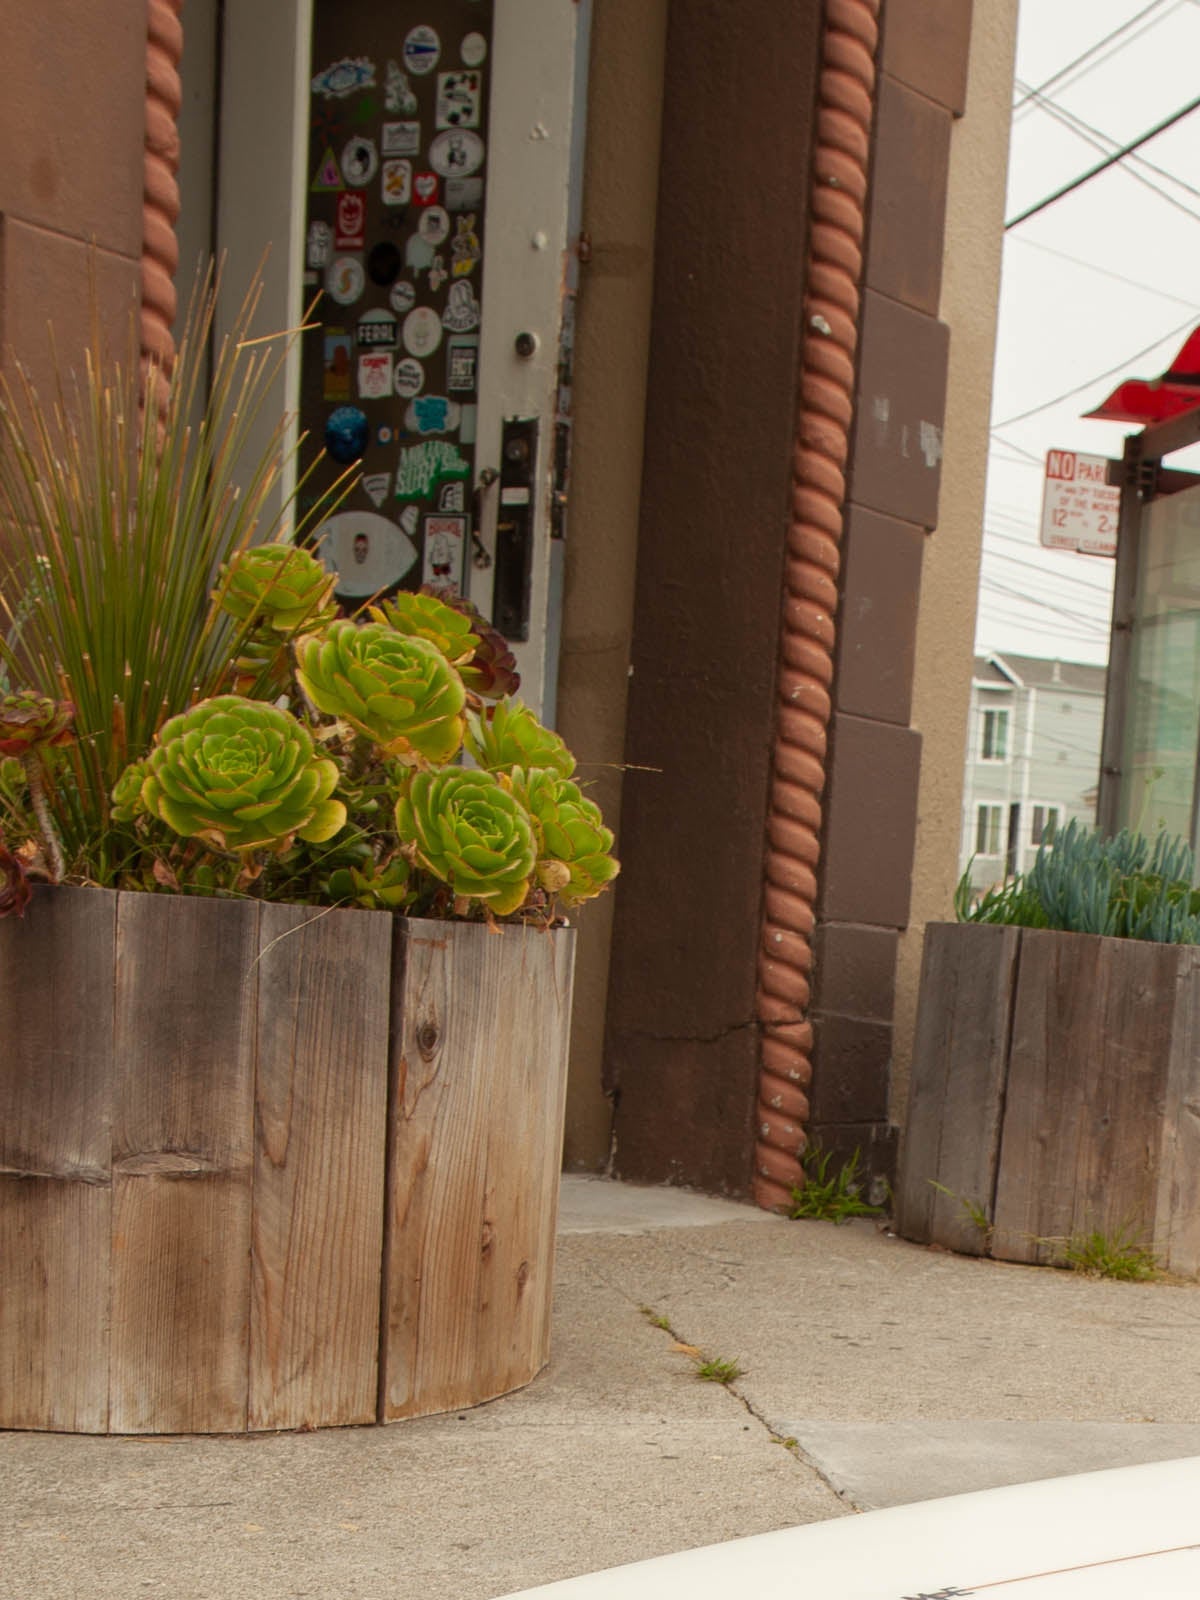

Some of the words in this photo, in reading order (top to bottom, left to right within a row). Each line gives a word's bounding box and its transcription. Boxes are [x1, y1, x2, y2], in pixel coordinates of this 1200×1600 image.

[1048, 452, 1074, 480] NO
[1077, 462, 1105, 481] PAR
[1052, 508, 1067, 527] 12
[1097, 514, 1109, 533] 2
